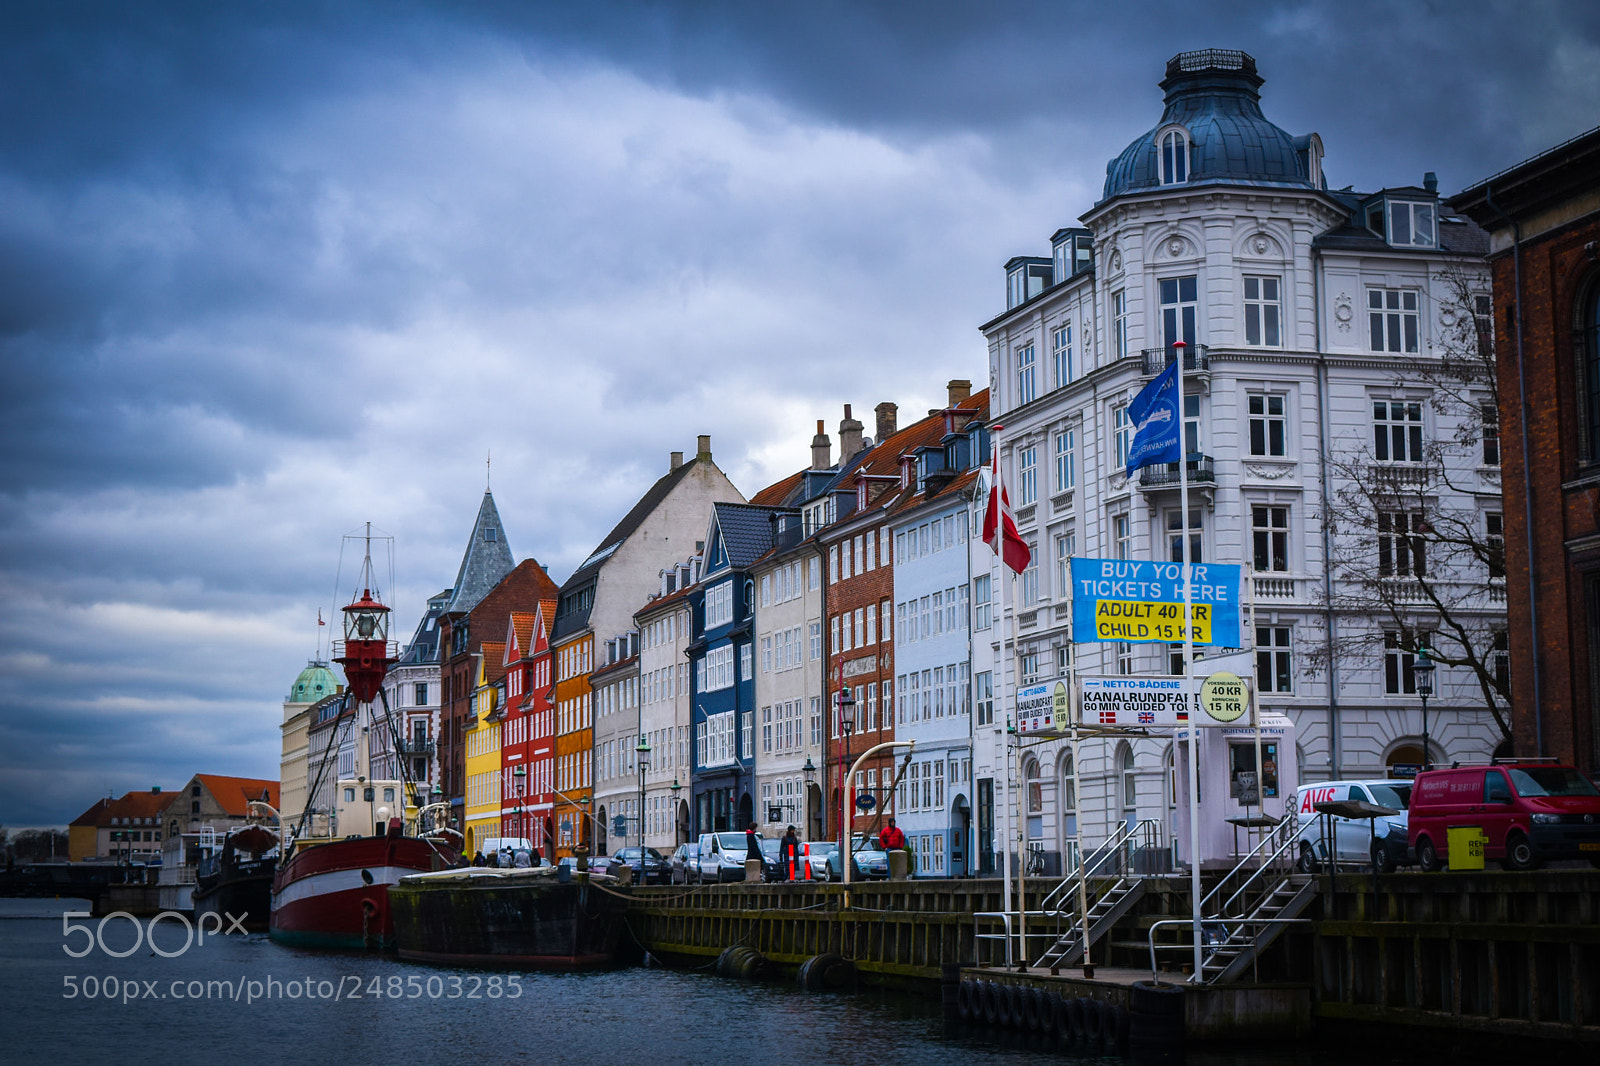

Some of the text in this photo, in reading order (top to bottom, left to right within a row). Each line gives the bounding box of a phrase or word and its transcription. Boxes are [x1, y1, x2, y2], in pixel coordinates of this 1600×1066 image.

[1101, 562, 1208, 581] BUY YOUR
[1081, 580, 1228, 601] TICKETS HERE
[1098, 602, 1154, 618] ADULT
[1158, 605, 1178, 619] 40
[1099, 623, 1203, 640] CHILD 15 KR
[1103, 680, 1180, 689] NETTO-BÅDENE
[1211, 686, 1241, 696] 40 KR
[1084, 703, 1097, 711] 60
[1099, 703, 1120, 711] MIN
[1123, 703, 1166, 711] GUIDED
[1209, 702, 1241, 711] 15 KR
[1300, 788, 1336, 813] AVIS
